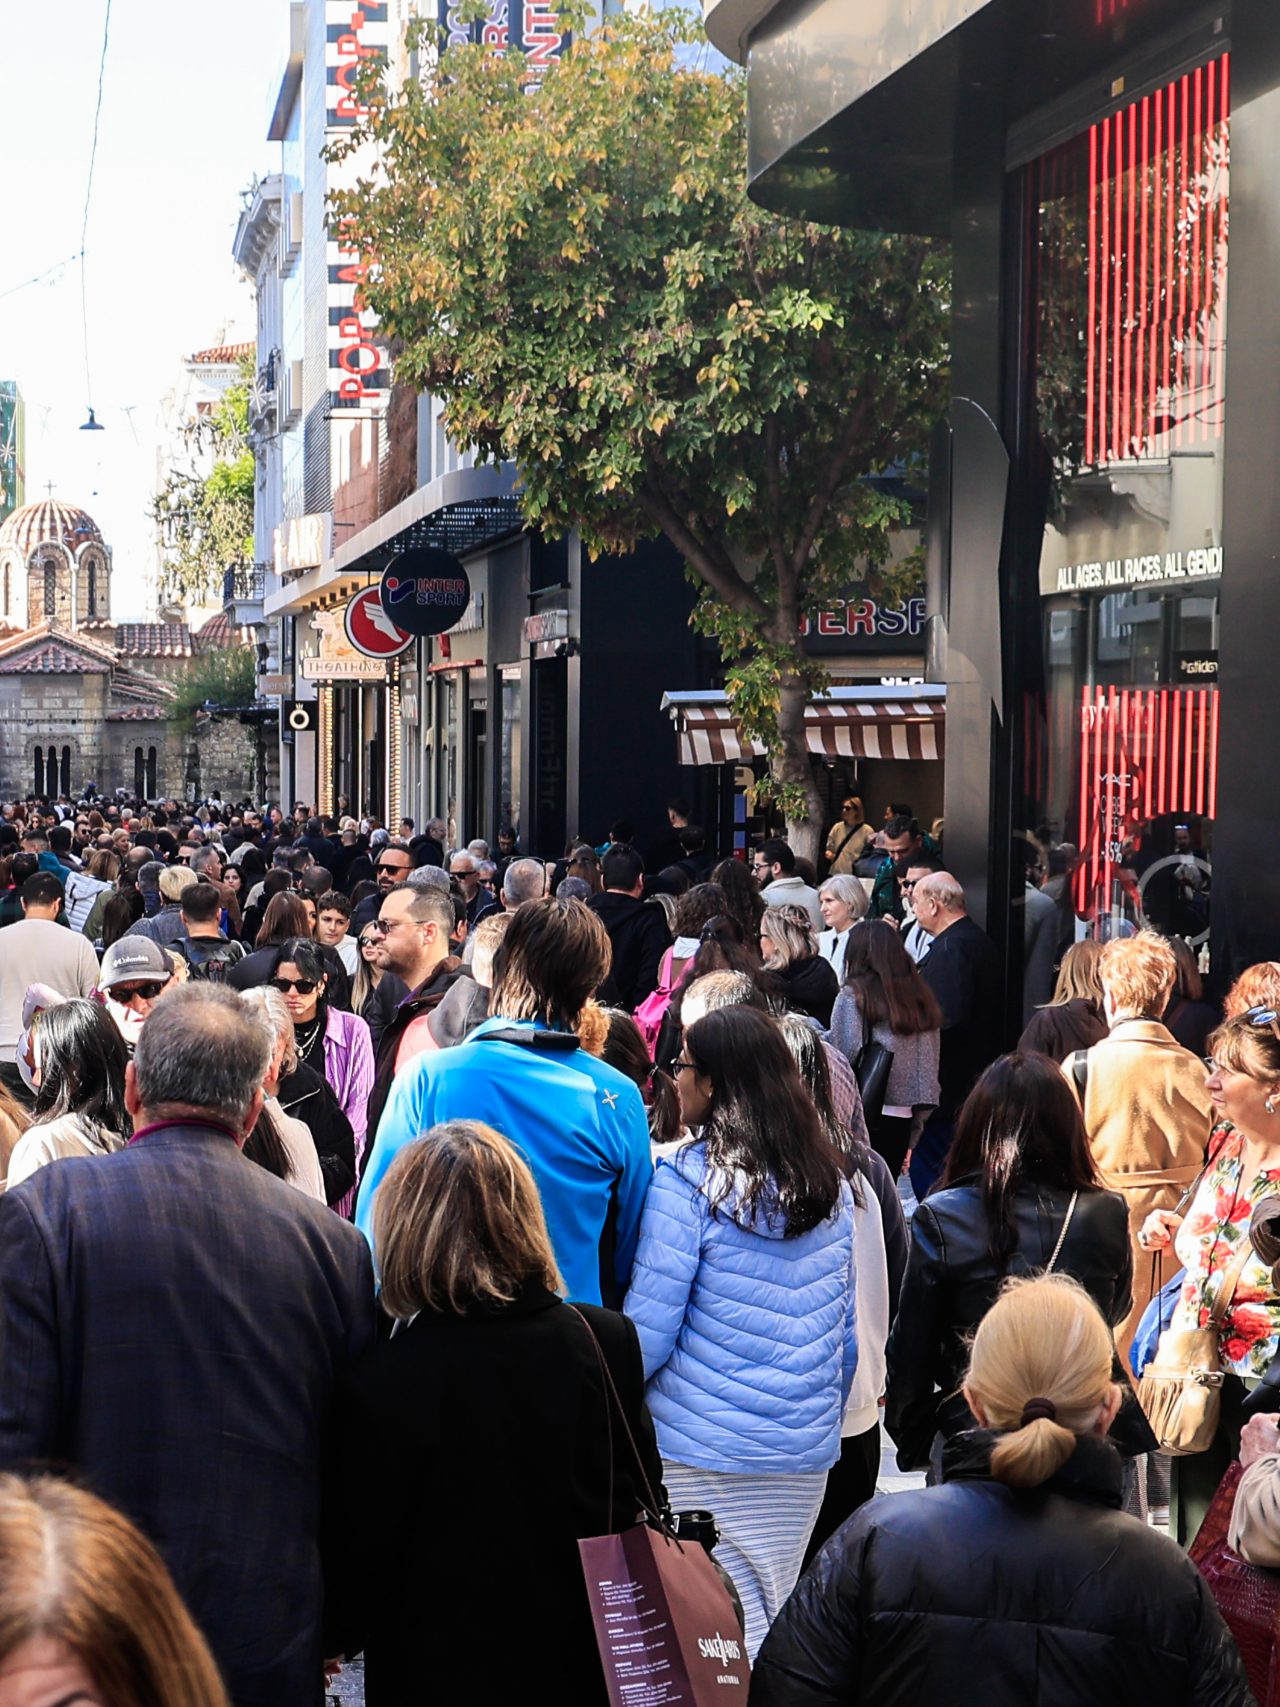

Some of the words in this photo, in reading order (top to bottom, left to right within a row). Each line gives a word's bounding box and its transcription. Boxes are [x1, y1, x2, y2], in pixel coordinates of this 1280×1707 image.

[1057, 567, 1074, 590] ALL
[1075, 562, 1104, 589] AGES.
[1105, 560, 1124, 586] ALL
[1125, 554, 1163, 583] RACES.
[1165, 552, 1186, 578] ALL
[418, 579, 465, 592] INTER
[417, 593, 464, 606] SPORT
